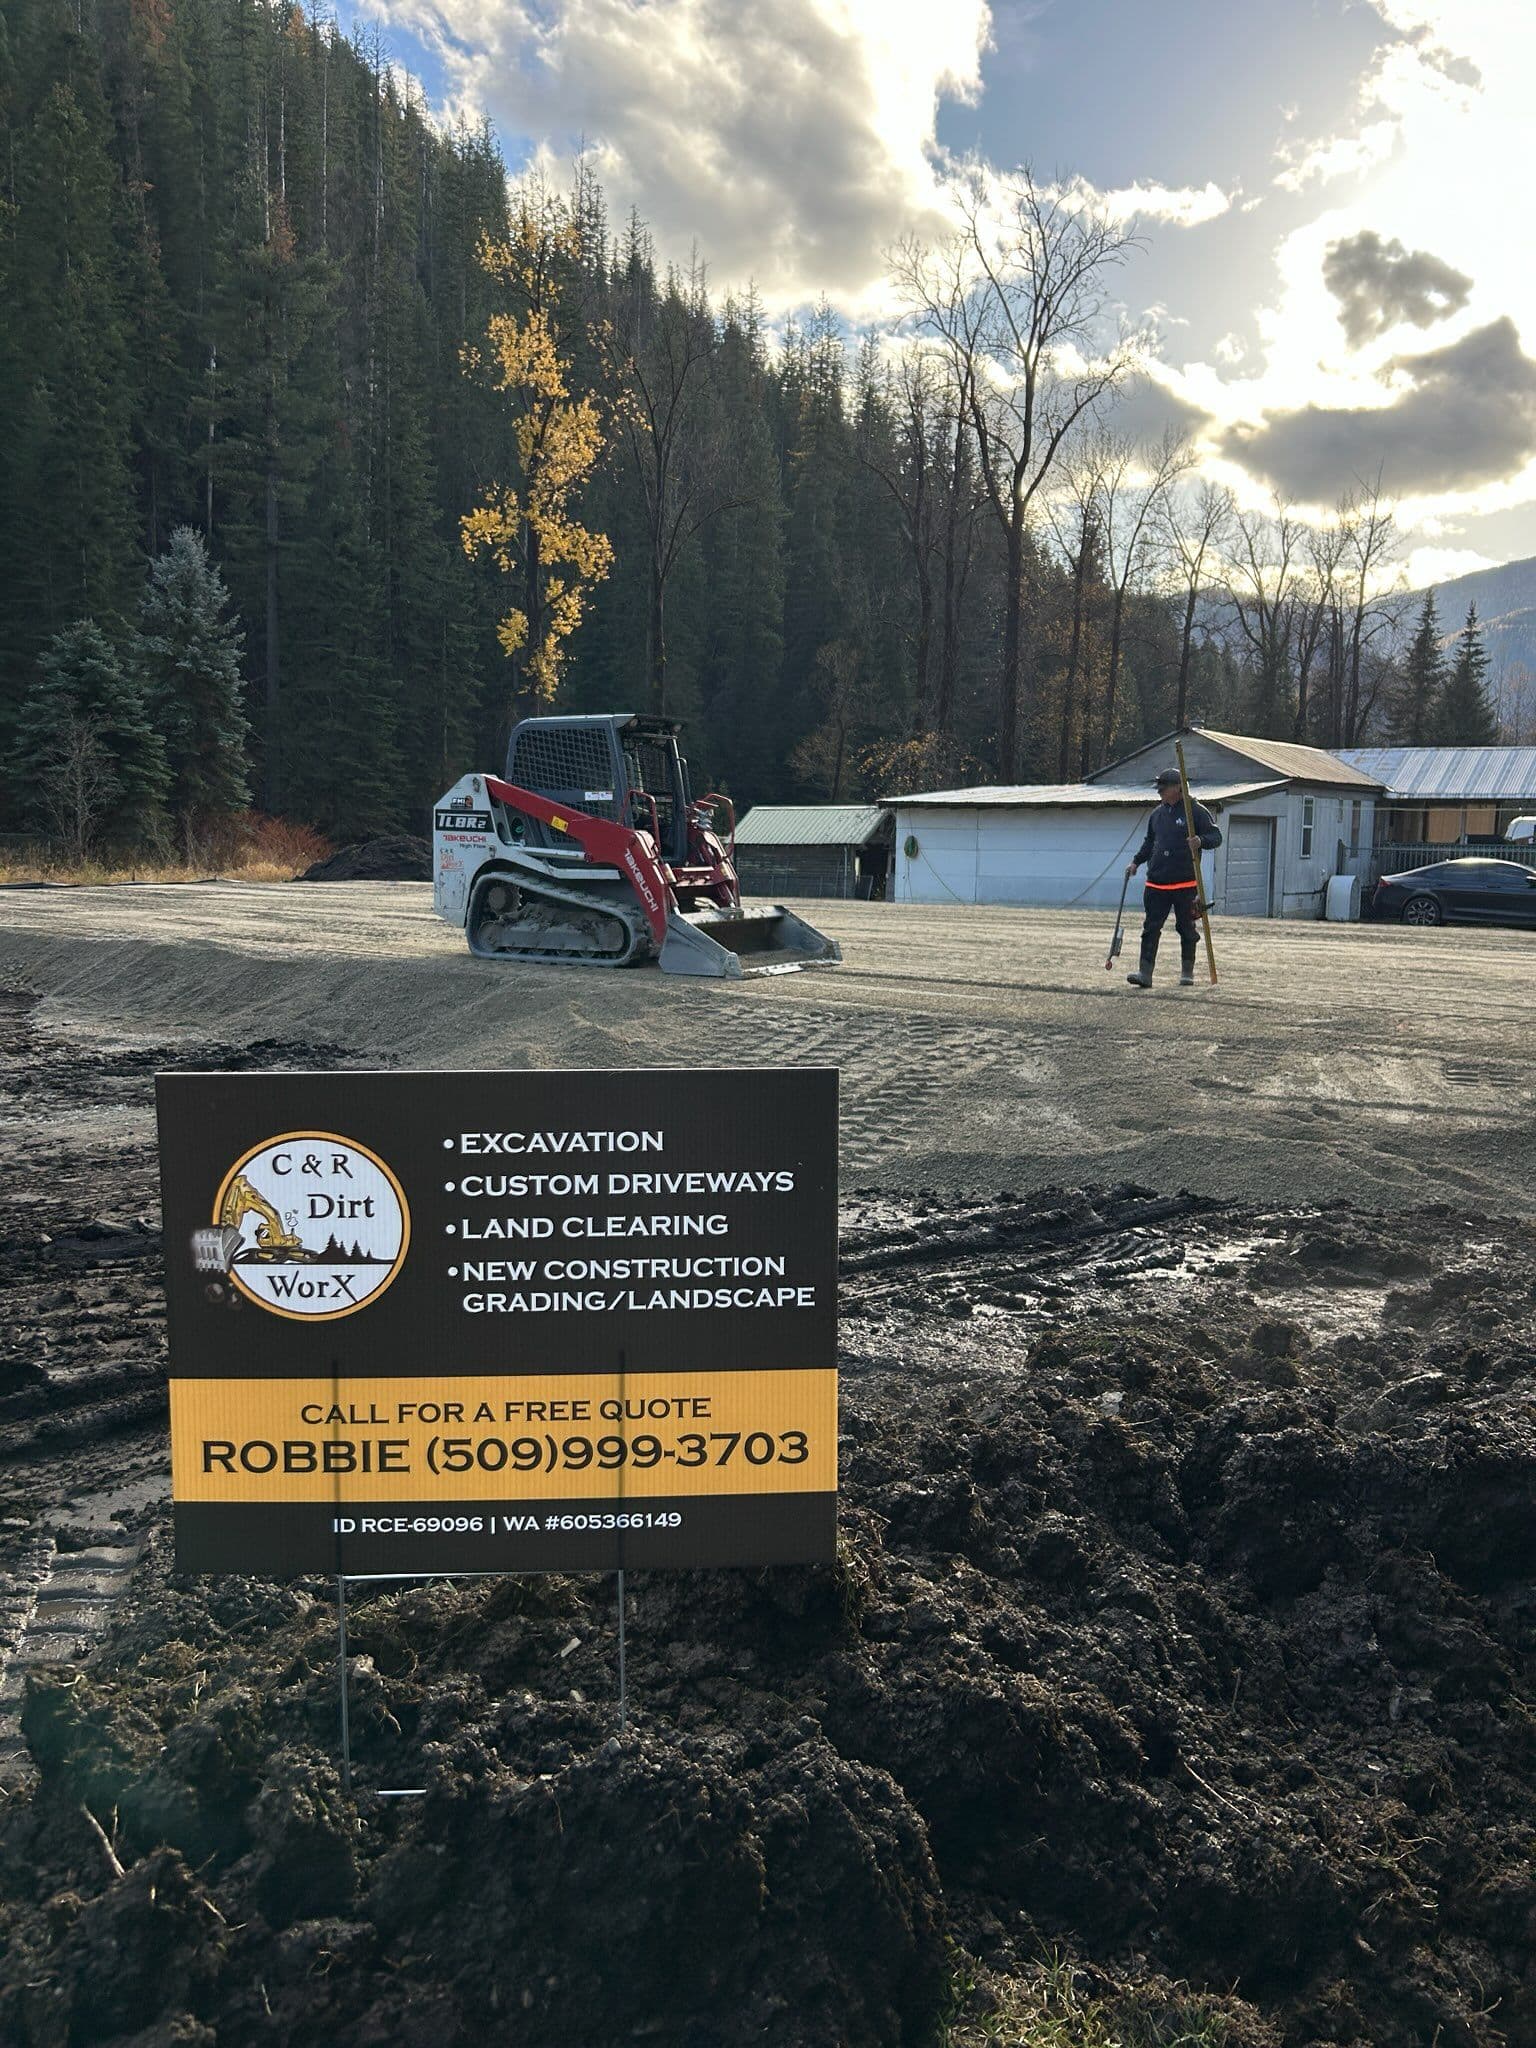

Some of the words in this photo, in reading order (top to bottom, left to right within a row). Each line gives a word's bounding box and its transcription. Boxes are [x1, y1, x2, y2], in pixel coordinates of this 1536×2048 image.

[443, 834, 487, 843] TAKEUCHI
[624, 848, 659, 912] TAKEUCHI
[460, 1131, 664, 1154] EXCAVATION
[272, 1154, 292, 1176] C
[301, 1154, 323, 1178] &
[331, 1154, 354, 1179] R
[460, 1174, 600, 1197] CUSTOM
[608, 1171, 795, 1194] DRIVEWAYS
[307, 1193, 375, 1219] Dirt
[462, 1217, 554, 1239] LAND
[562, 1214, 729, 1237] CLEARING
[463, 1261, 537, 1282] NEW
[544, 1256, 786, 1280] CONSTRUCTION
[267, 1270, 358, 1303] WorX
[463, 1286, 816, 1313] GRADING/LANDSCAPE
[301, 1403, 390, 1425] CALL
[398, 1402, 465, 1423] FOR
[473, 1402, 497, 1422] A
[504, 1400, 591, 1422] FREE
[599, 1397, 712, 1422] QUOTE
[202, 1438, 411, 1474] ROBBIE
[427, 1430, 810, 1476] (509)999-3703
[334, 1517, 356, 1533] ID
[361, 1516, 484, 1533] RCE-69096
[503, 1516, 541, 1531] WA
[544, 1511, 682, 1531] #605366149
